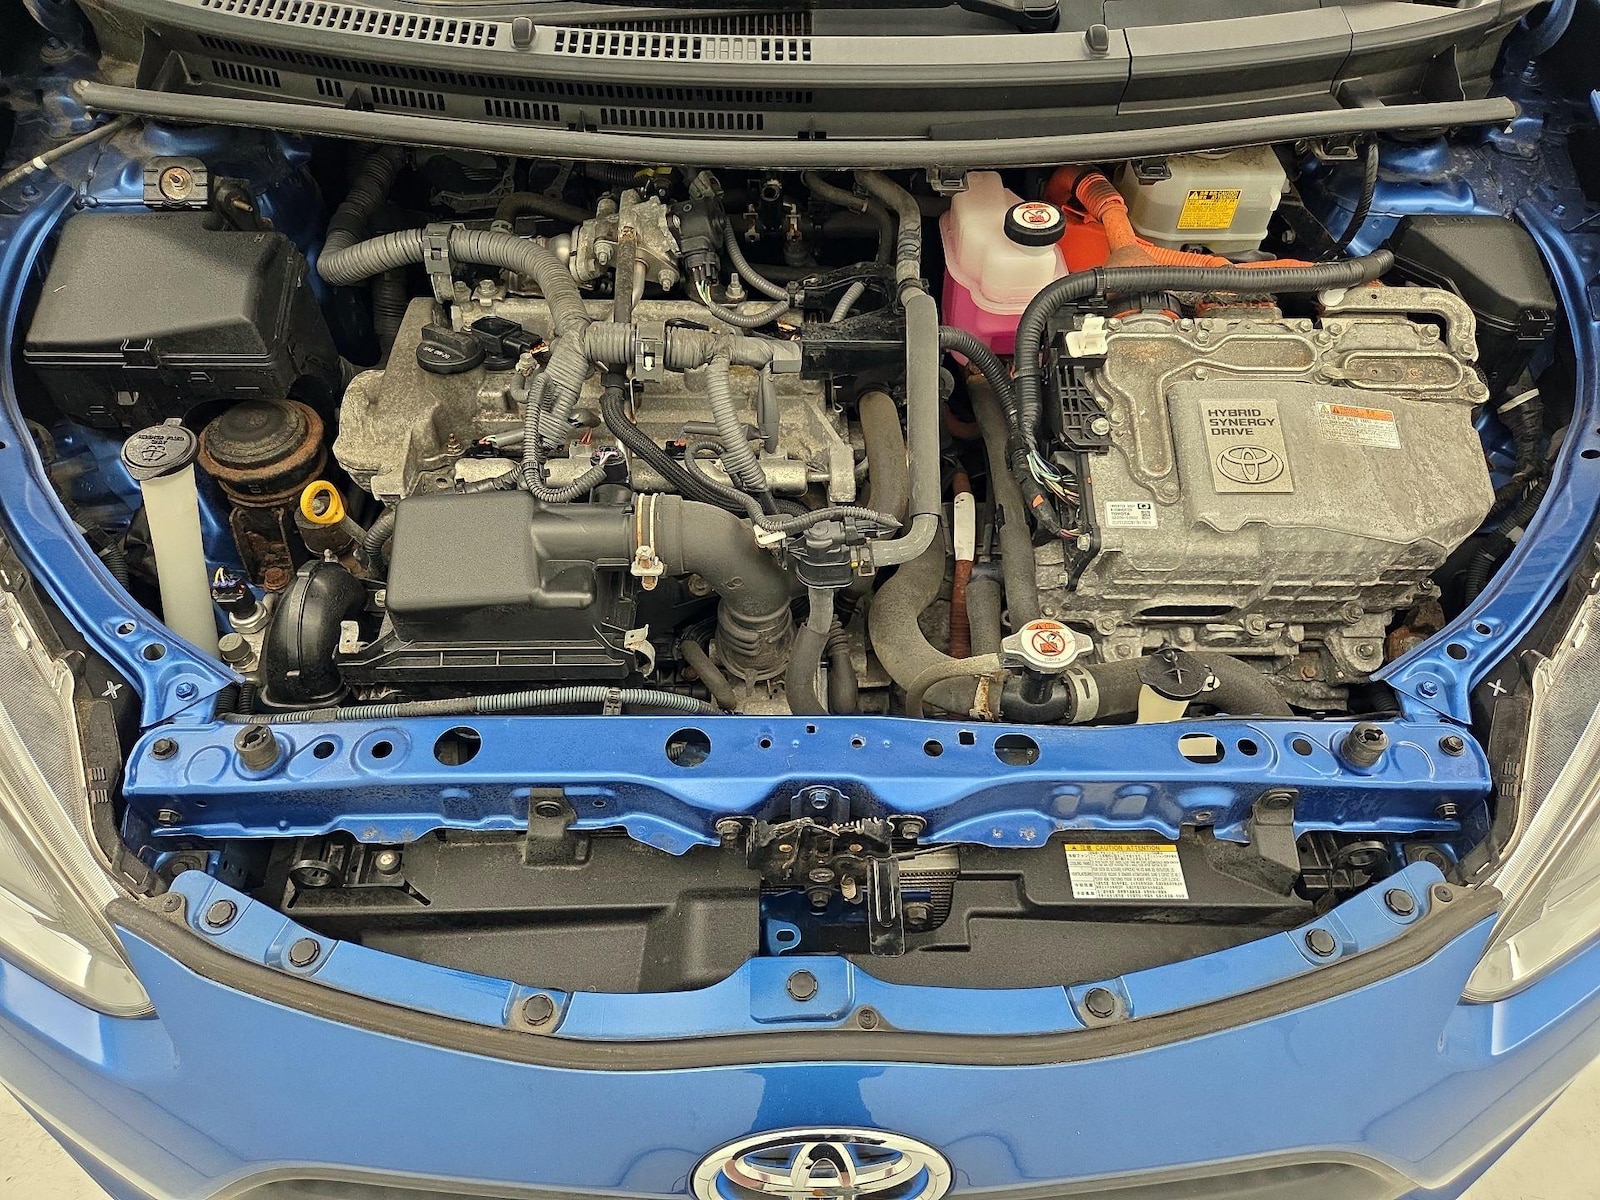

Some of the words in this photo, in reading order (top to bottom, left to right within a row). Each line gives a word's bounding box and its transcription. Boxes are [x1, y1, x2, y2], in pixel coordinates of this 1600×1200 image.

[1207, 409, 1261, 417] HYBRID
[1209, 418, 1275, 426] SYNERGY
[1211, 428, 1254, 436] DRIVE
